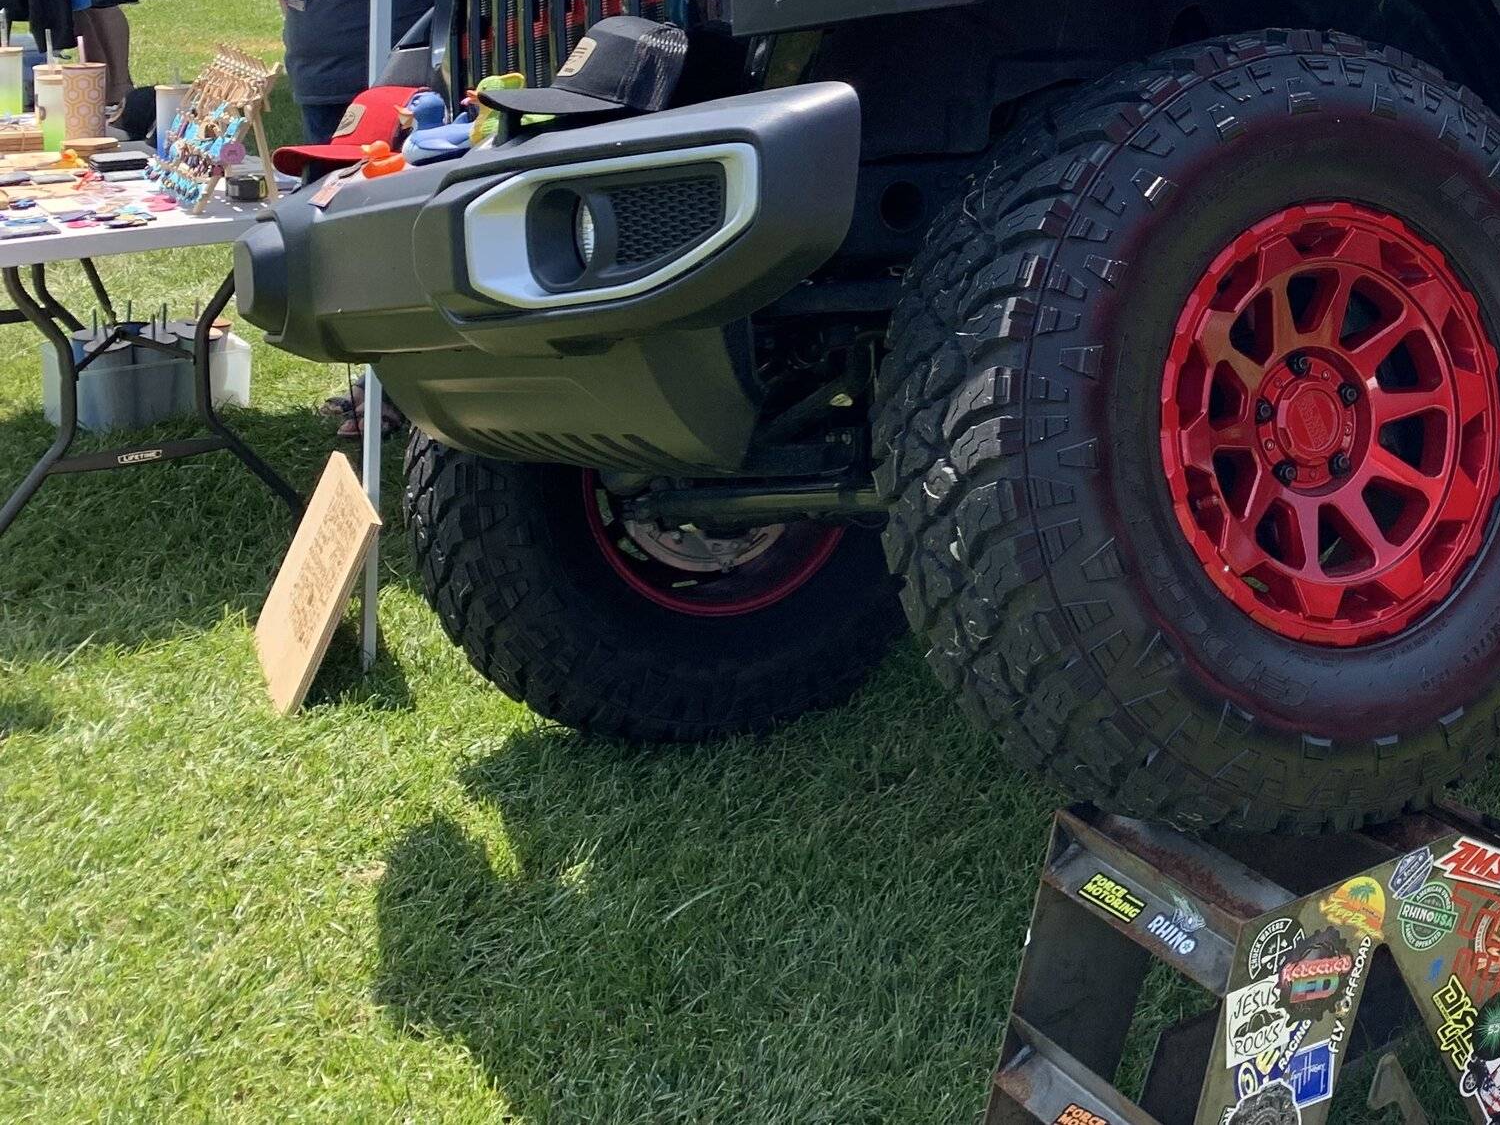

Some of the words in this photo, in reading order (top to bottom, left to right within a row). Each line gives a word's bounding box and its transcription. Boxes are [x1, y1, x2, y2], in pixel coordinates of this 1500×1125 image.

[1083, 882, 1141, 919] MOTORING
[1090, 873, 1128, 899] FORCE
[1147, 914, 1197, 955] RHINO
[1234, 987, 1281, 1019] JESUS
[1233, 1022, 1282, 1057] ROCKS
[1278, 1019, 1312, 1071] RACING
